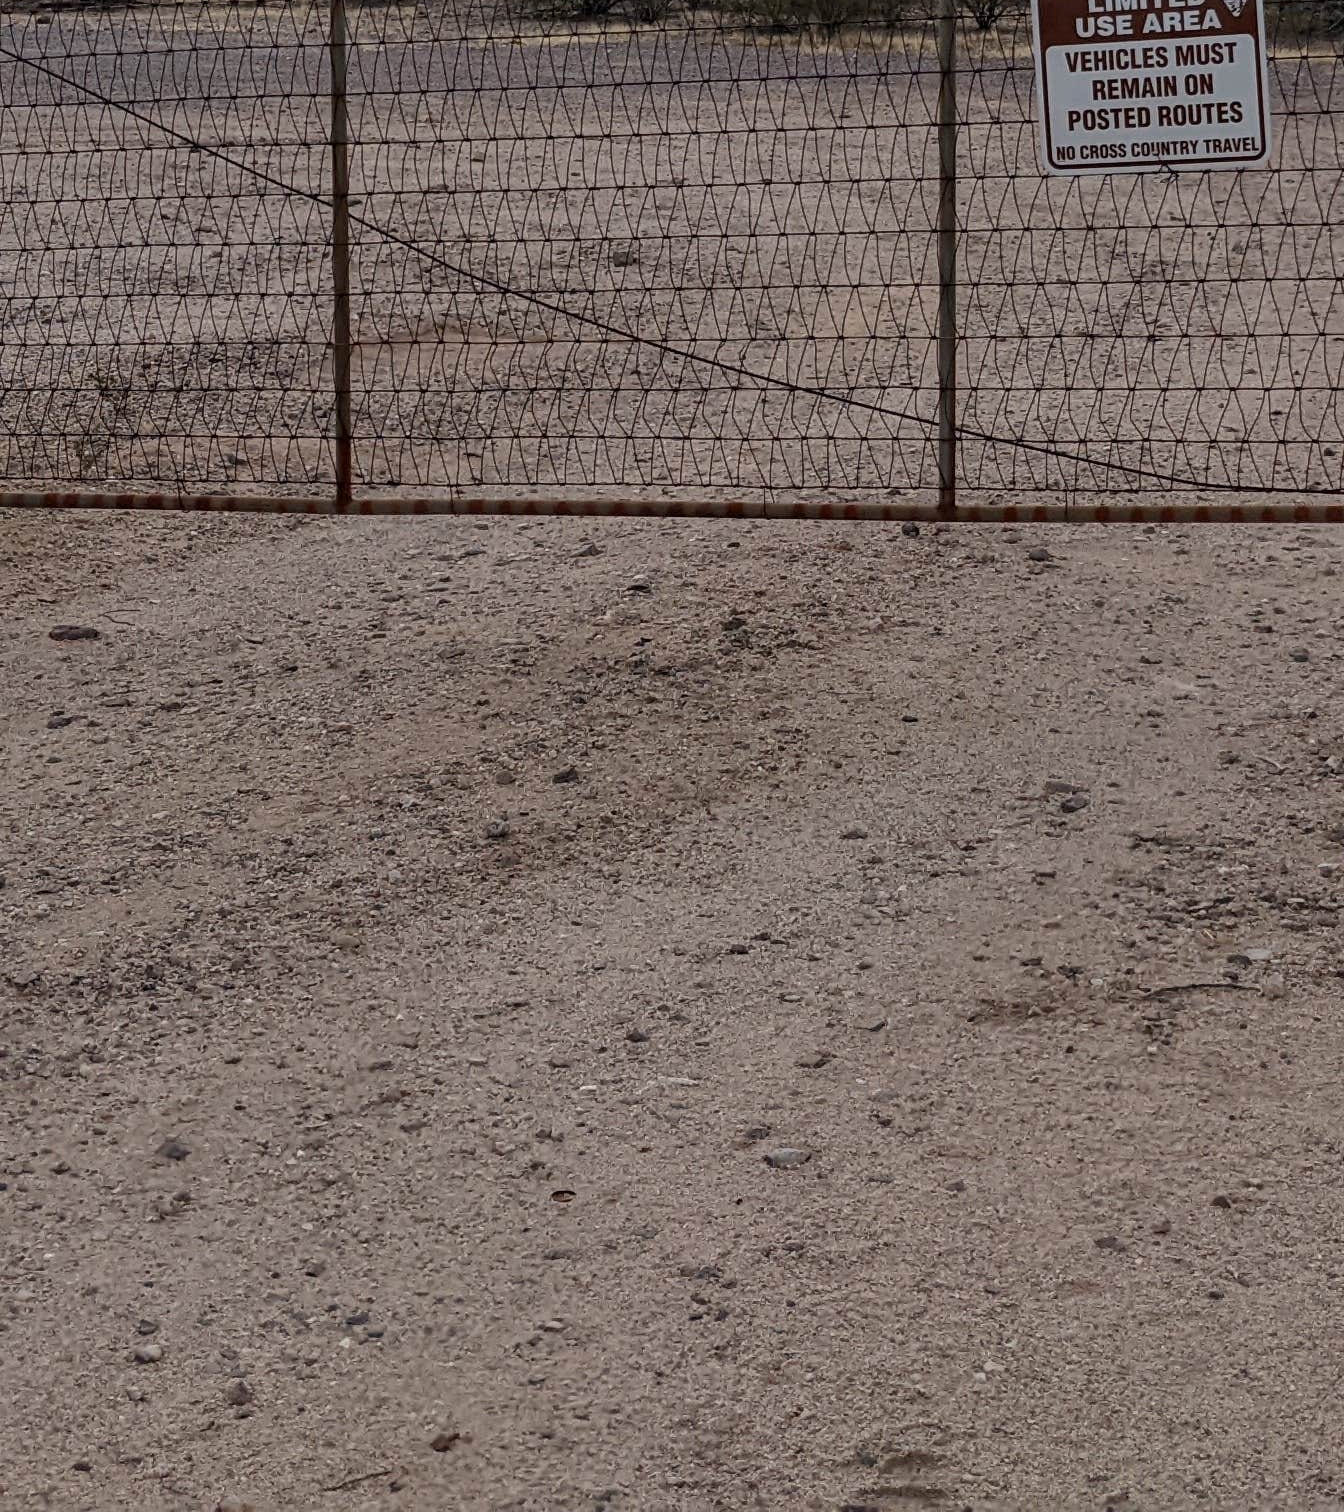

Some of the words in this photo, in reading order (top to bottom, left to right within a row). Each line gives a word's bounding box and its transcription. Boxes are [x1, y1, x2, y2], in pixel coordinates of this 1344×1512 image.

[1075, 17, 1134, 38] USE
[1142, 9, 1222, 34] AREA
[1065, 46, 1168, 72] VEHICLES
[1175, 42, 1237, 66] MUST
[1092, 75, 1178, 100] REMAIN
[1184, 73, 1214, 96] ON
[1067, 106, 1151, 131] POSTED
[1158, 101, 1243, 127] ROUTES
[1056, 146, 1076, 161] NO
[1080, 143, 1127, 159] CROSS
[1131, 139, 1199, 157] COUNTRY
[1203, 137, 1259, 153] TRAVEL
